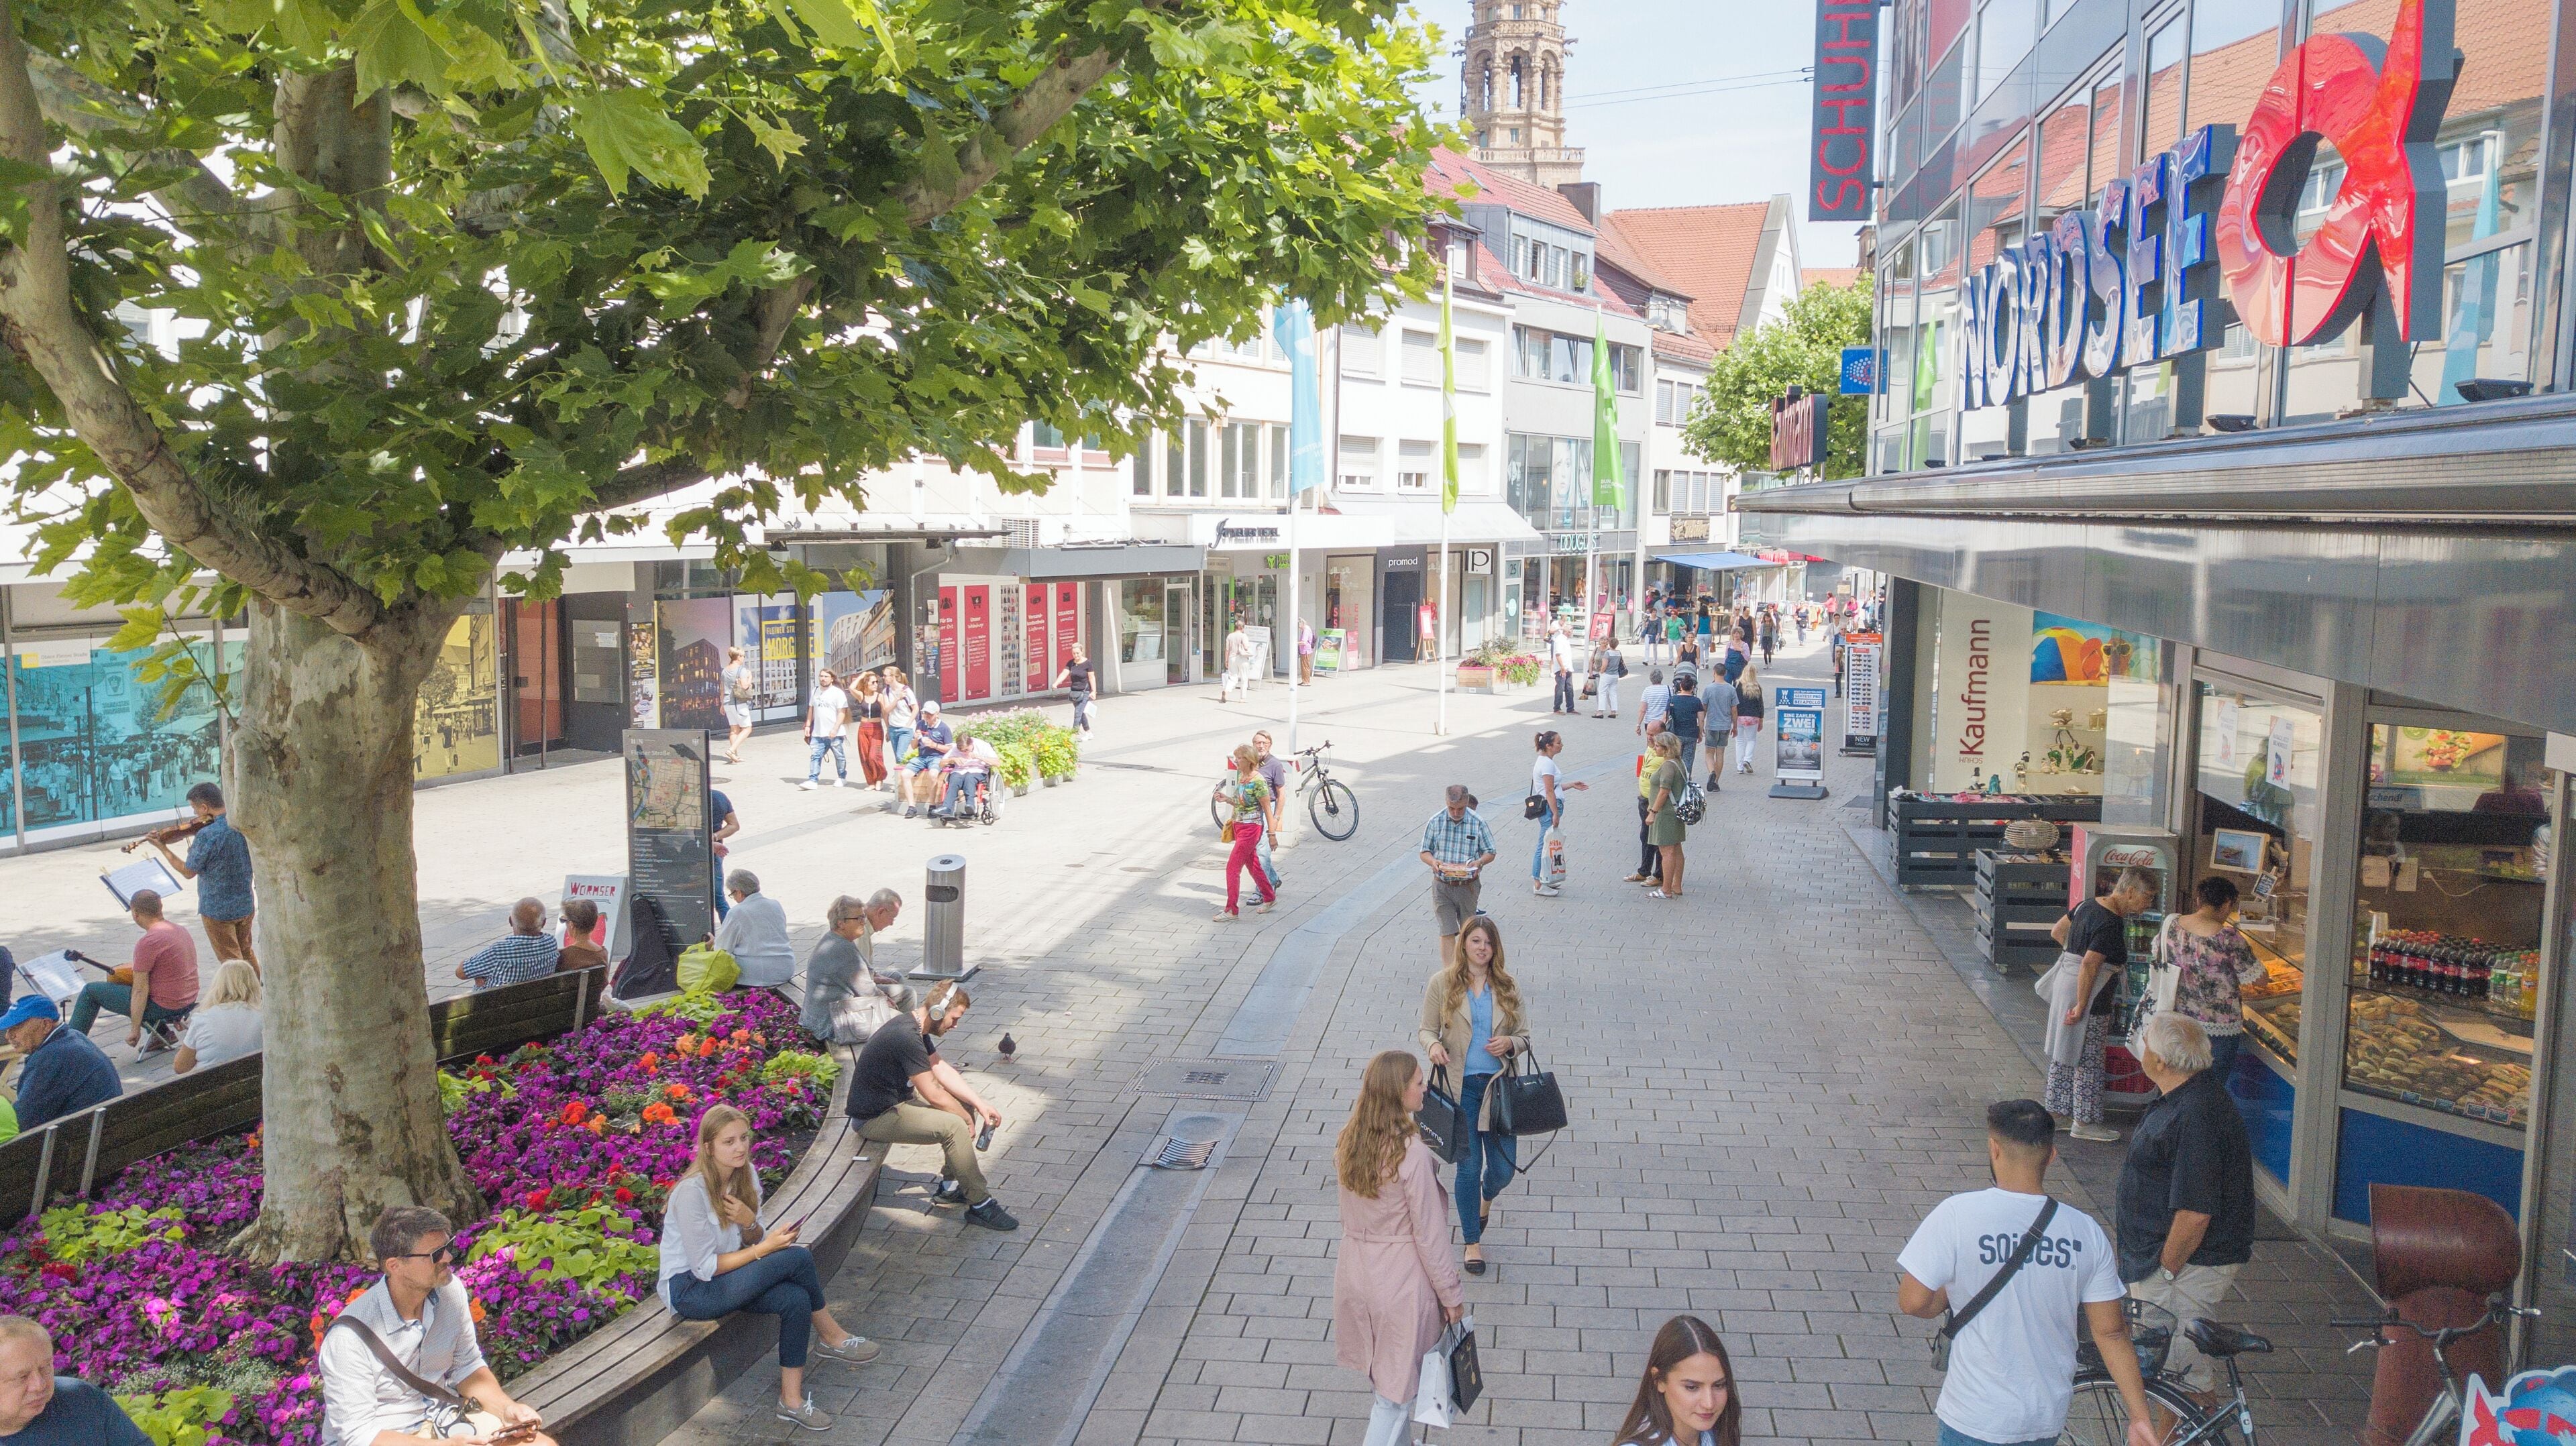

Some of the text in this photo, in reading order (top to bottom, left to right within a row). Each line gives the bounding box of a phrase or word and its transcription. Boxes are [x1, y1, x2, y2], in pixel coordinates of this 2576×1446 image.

[1817, 0, 1872, 211] SCHUH
[1959, 123, 2214, 412] NORDSEE
[1560, 533, 1597, 551] DOUGLS
[1388, 557, 1417, 569] promod
[1510, 563, 1517, 575] 25
[1960, 620, 1990, 755] Kaufmann
[1784, 718, 1815, 728] ZWEI
[2367, 793, 2402, 802] schend!
[570, 882, 616, 897] WORMSER
